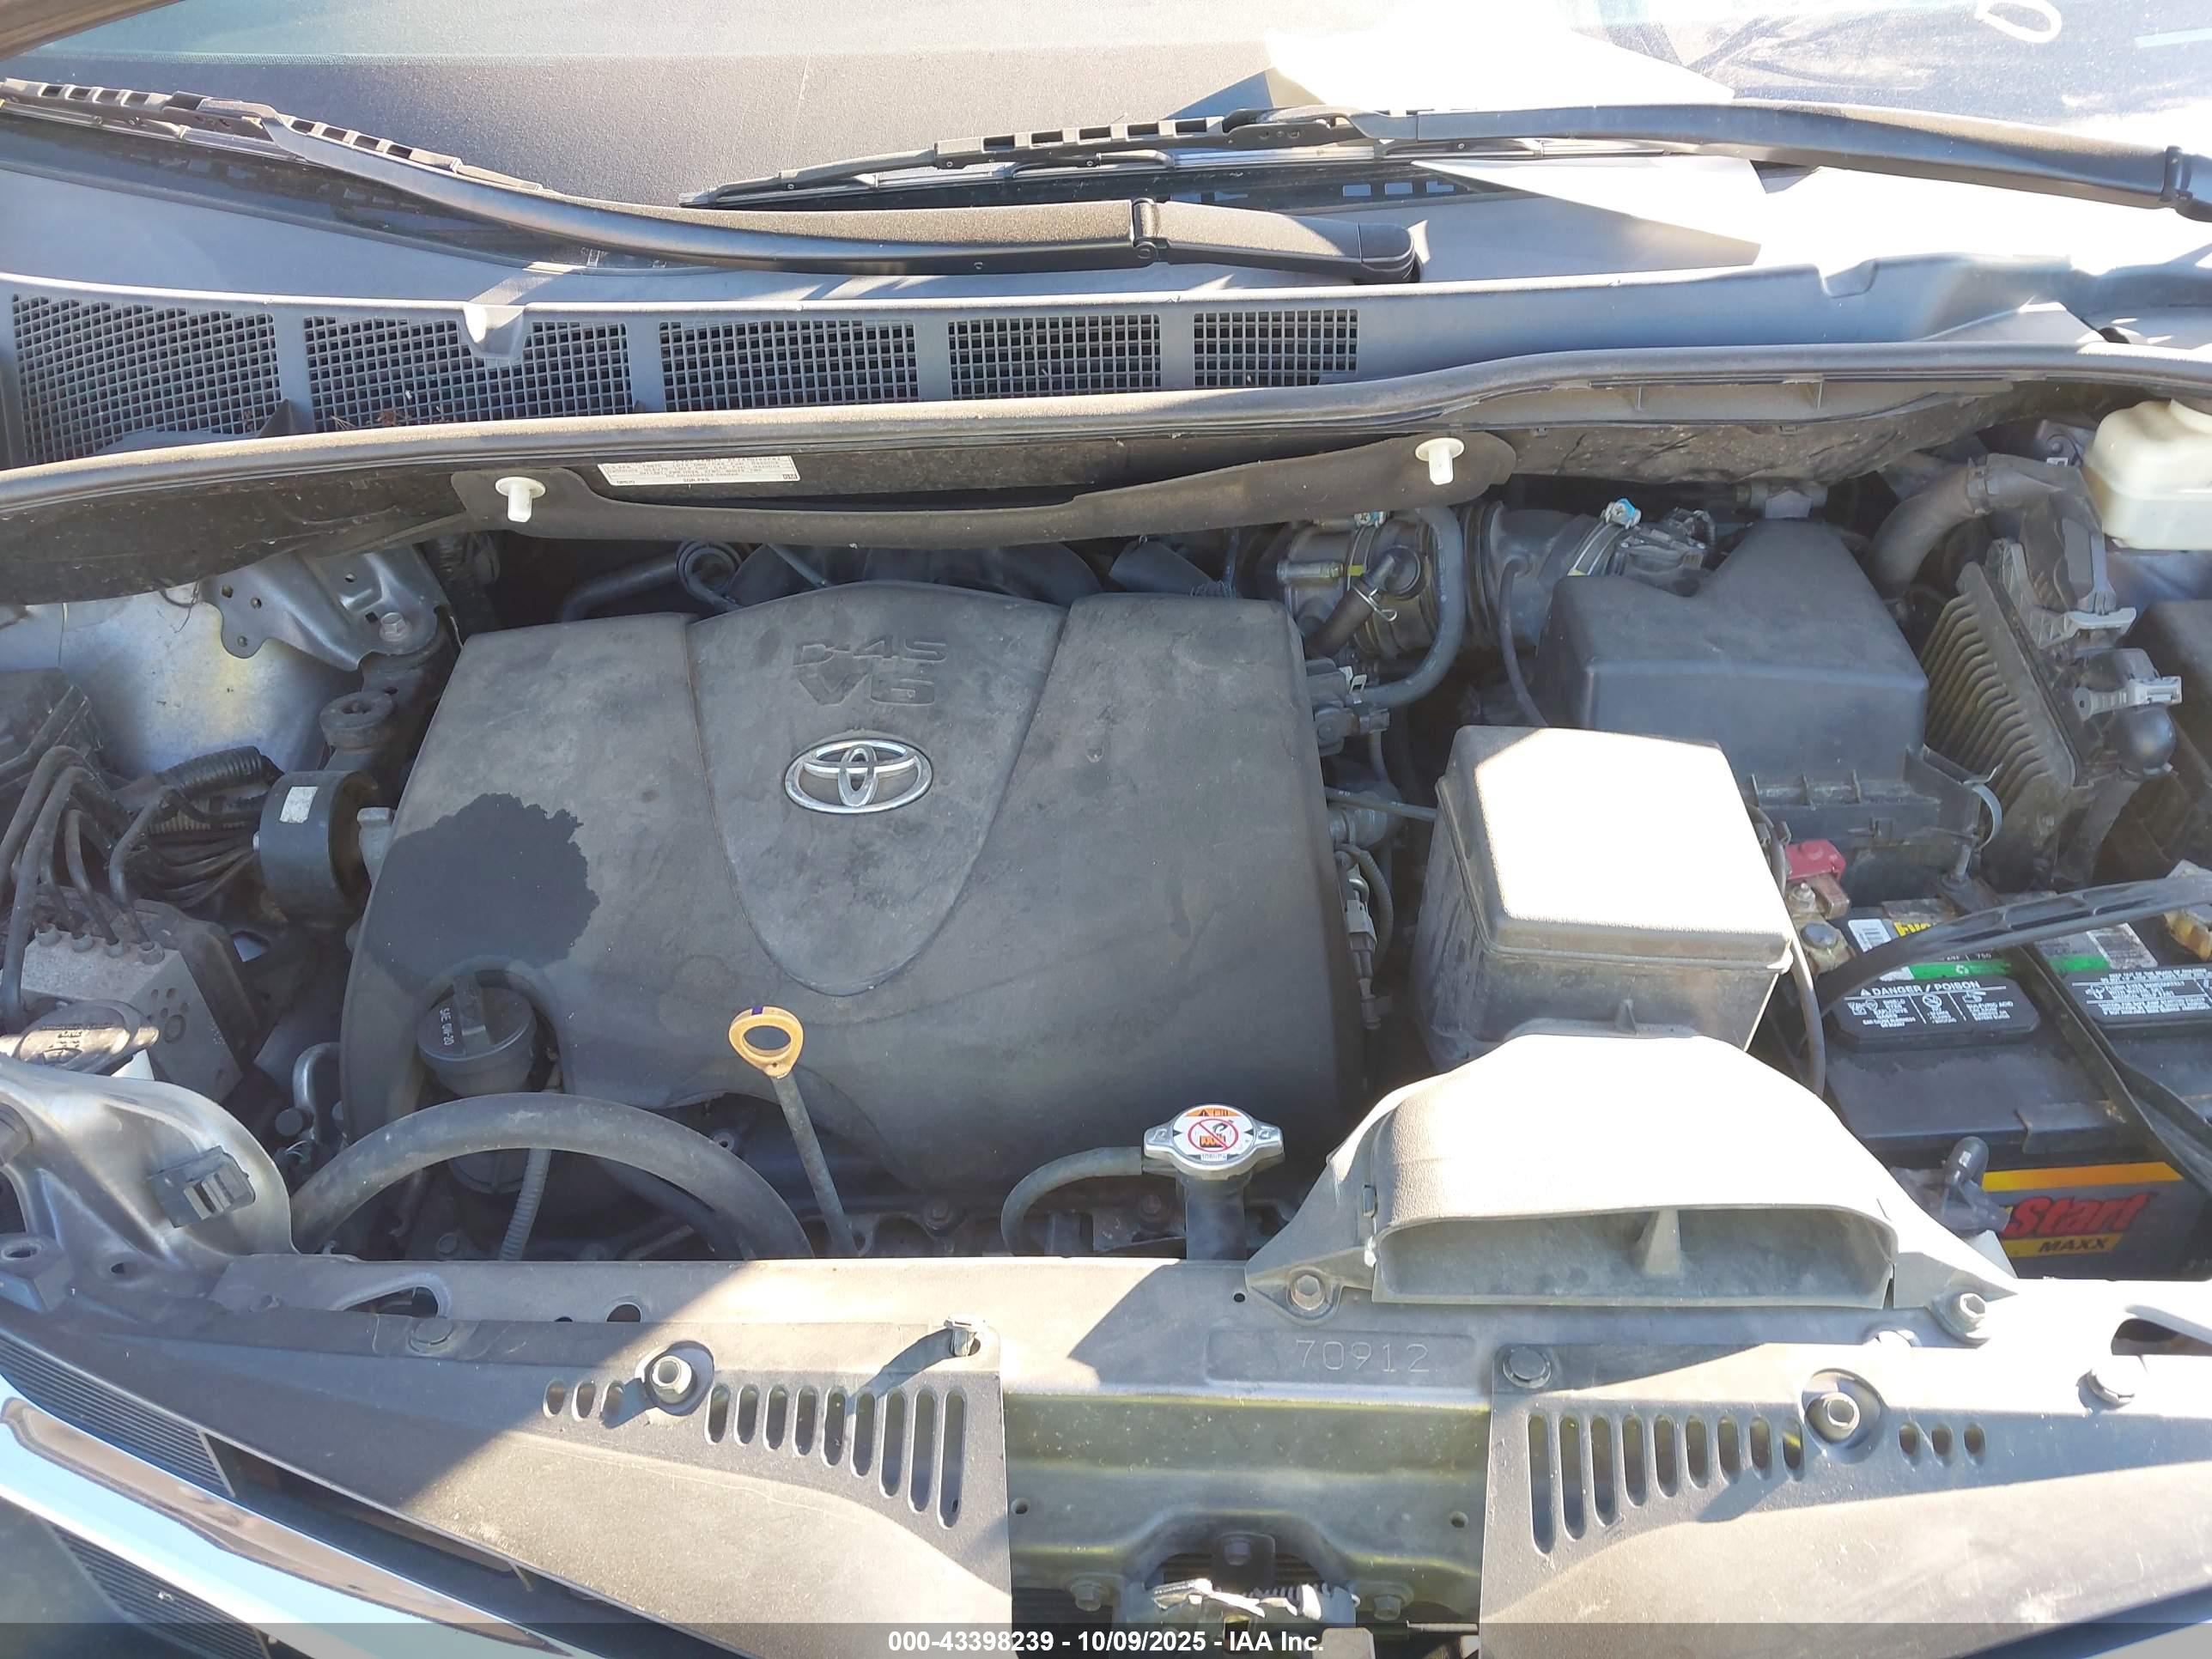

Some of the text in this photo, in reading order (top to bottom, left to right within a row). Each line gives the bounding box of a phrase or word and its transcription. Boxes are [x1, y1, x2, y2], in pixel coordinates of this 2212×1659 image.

[793, 634, 947, 668] D-4S
[797, 671, 936, 707] V6
[1872, 984, 1923, 997] DANGER
[1934, 981, 1980, 992] POISON
[2038, 1238, 2109, 1254] MAXX
[1296, 1339, 1430, 1373] 70912
